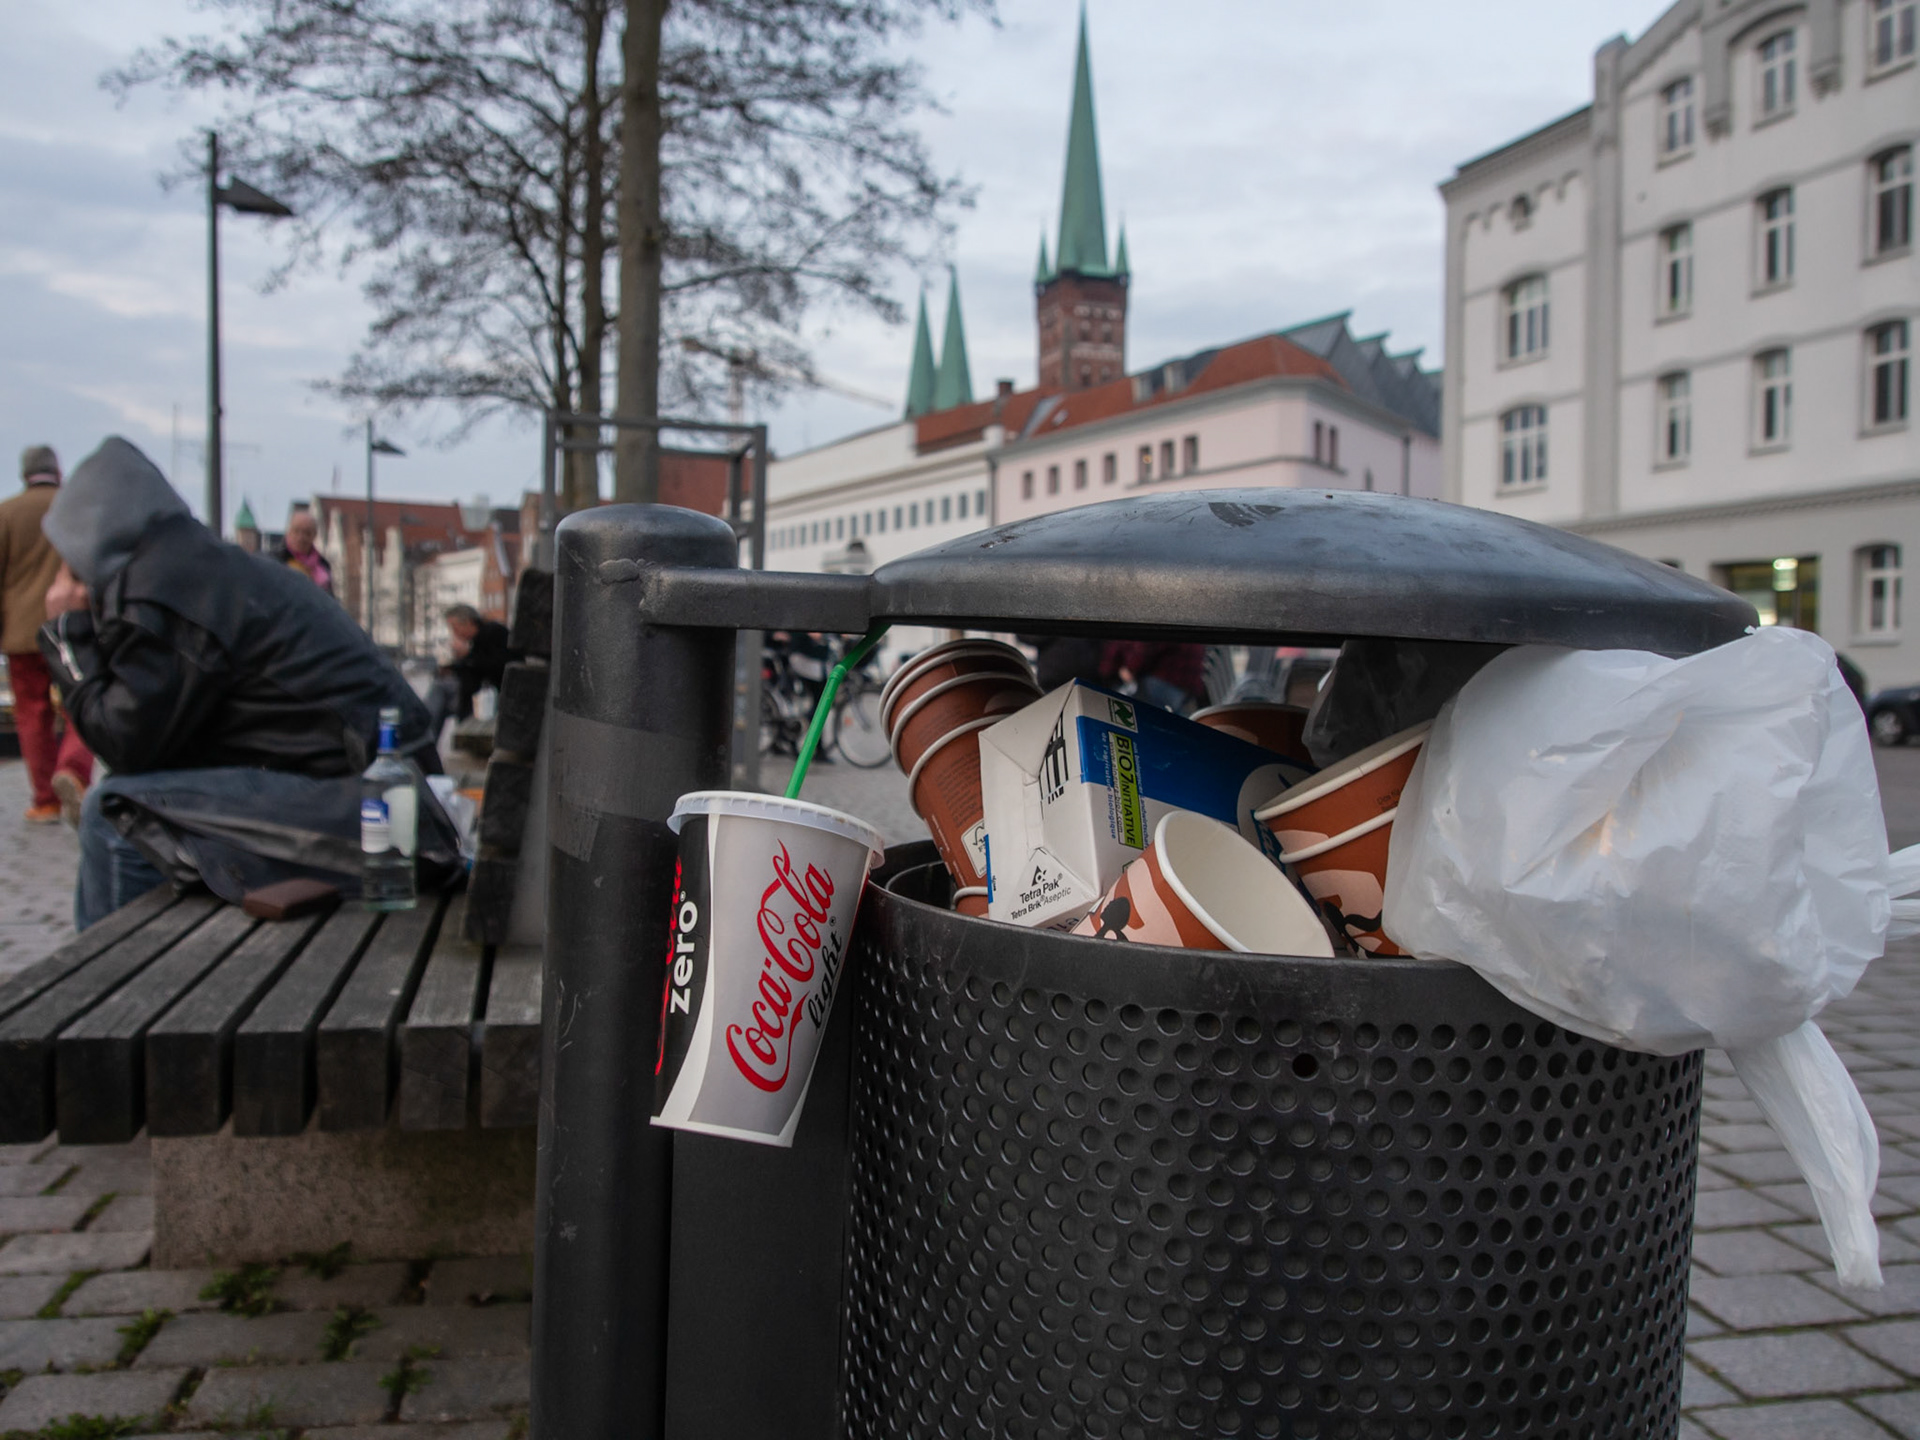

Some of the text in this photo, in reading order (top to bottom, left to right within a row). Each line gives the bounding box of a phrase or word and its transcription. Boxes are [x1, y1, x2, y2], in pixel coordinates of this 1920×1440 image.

[1011, 887, 1072, 920] Tetra Brik Aseptic
[1020, 879, 1060, 904] Tetra Pak
[670, 901, 698, 1015] zero
[726, 839, 835, 1093] Coca-Cola
[808, 931, 842, 1030] light
